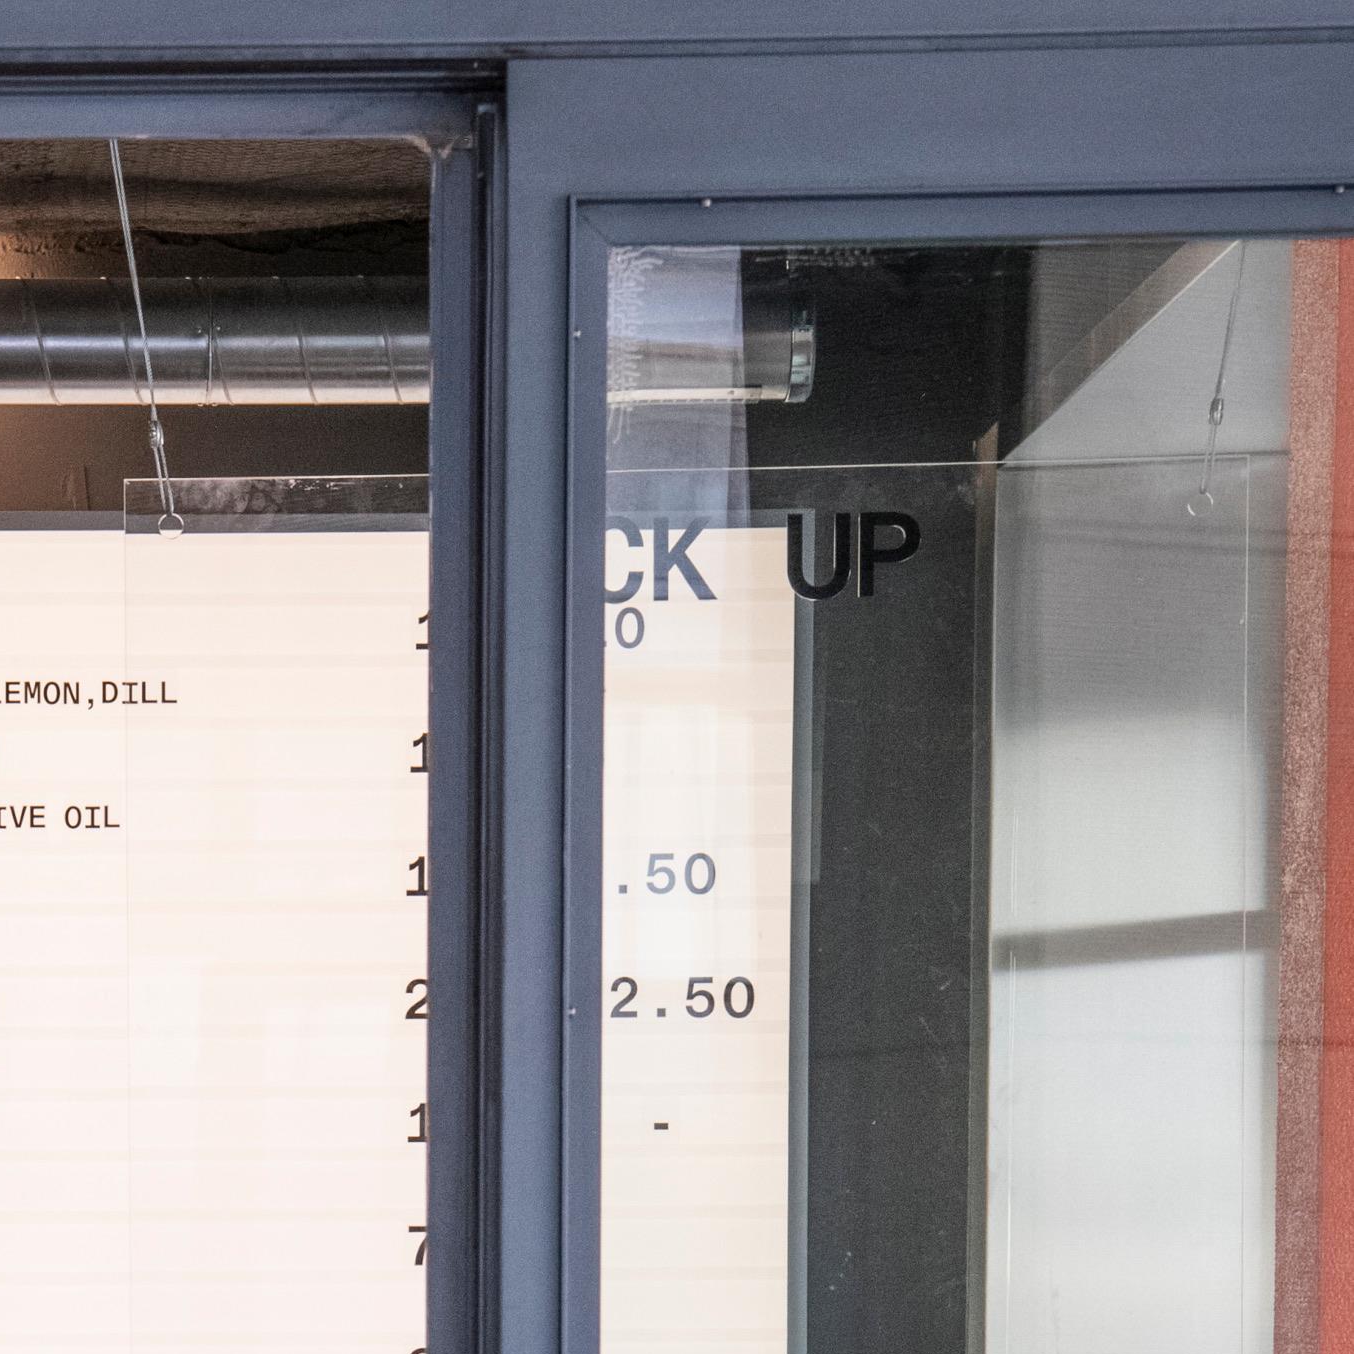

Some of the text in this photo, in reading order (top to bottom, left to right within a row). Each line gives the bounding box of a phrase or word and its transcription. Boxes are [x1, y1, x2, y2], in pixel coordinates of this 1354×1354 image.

[787, 511, 921, 600] UP
[64, 805, 120, 830] OIL
[609, 975, 756, 1019] 2.50
